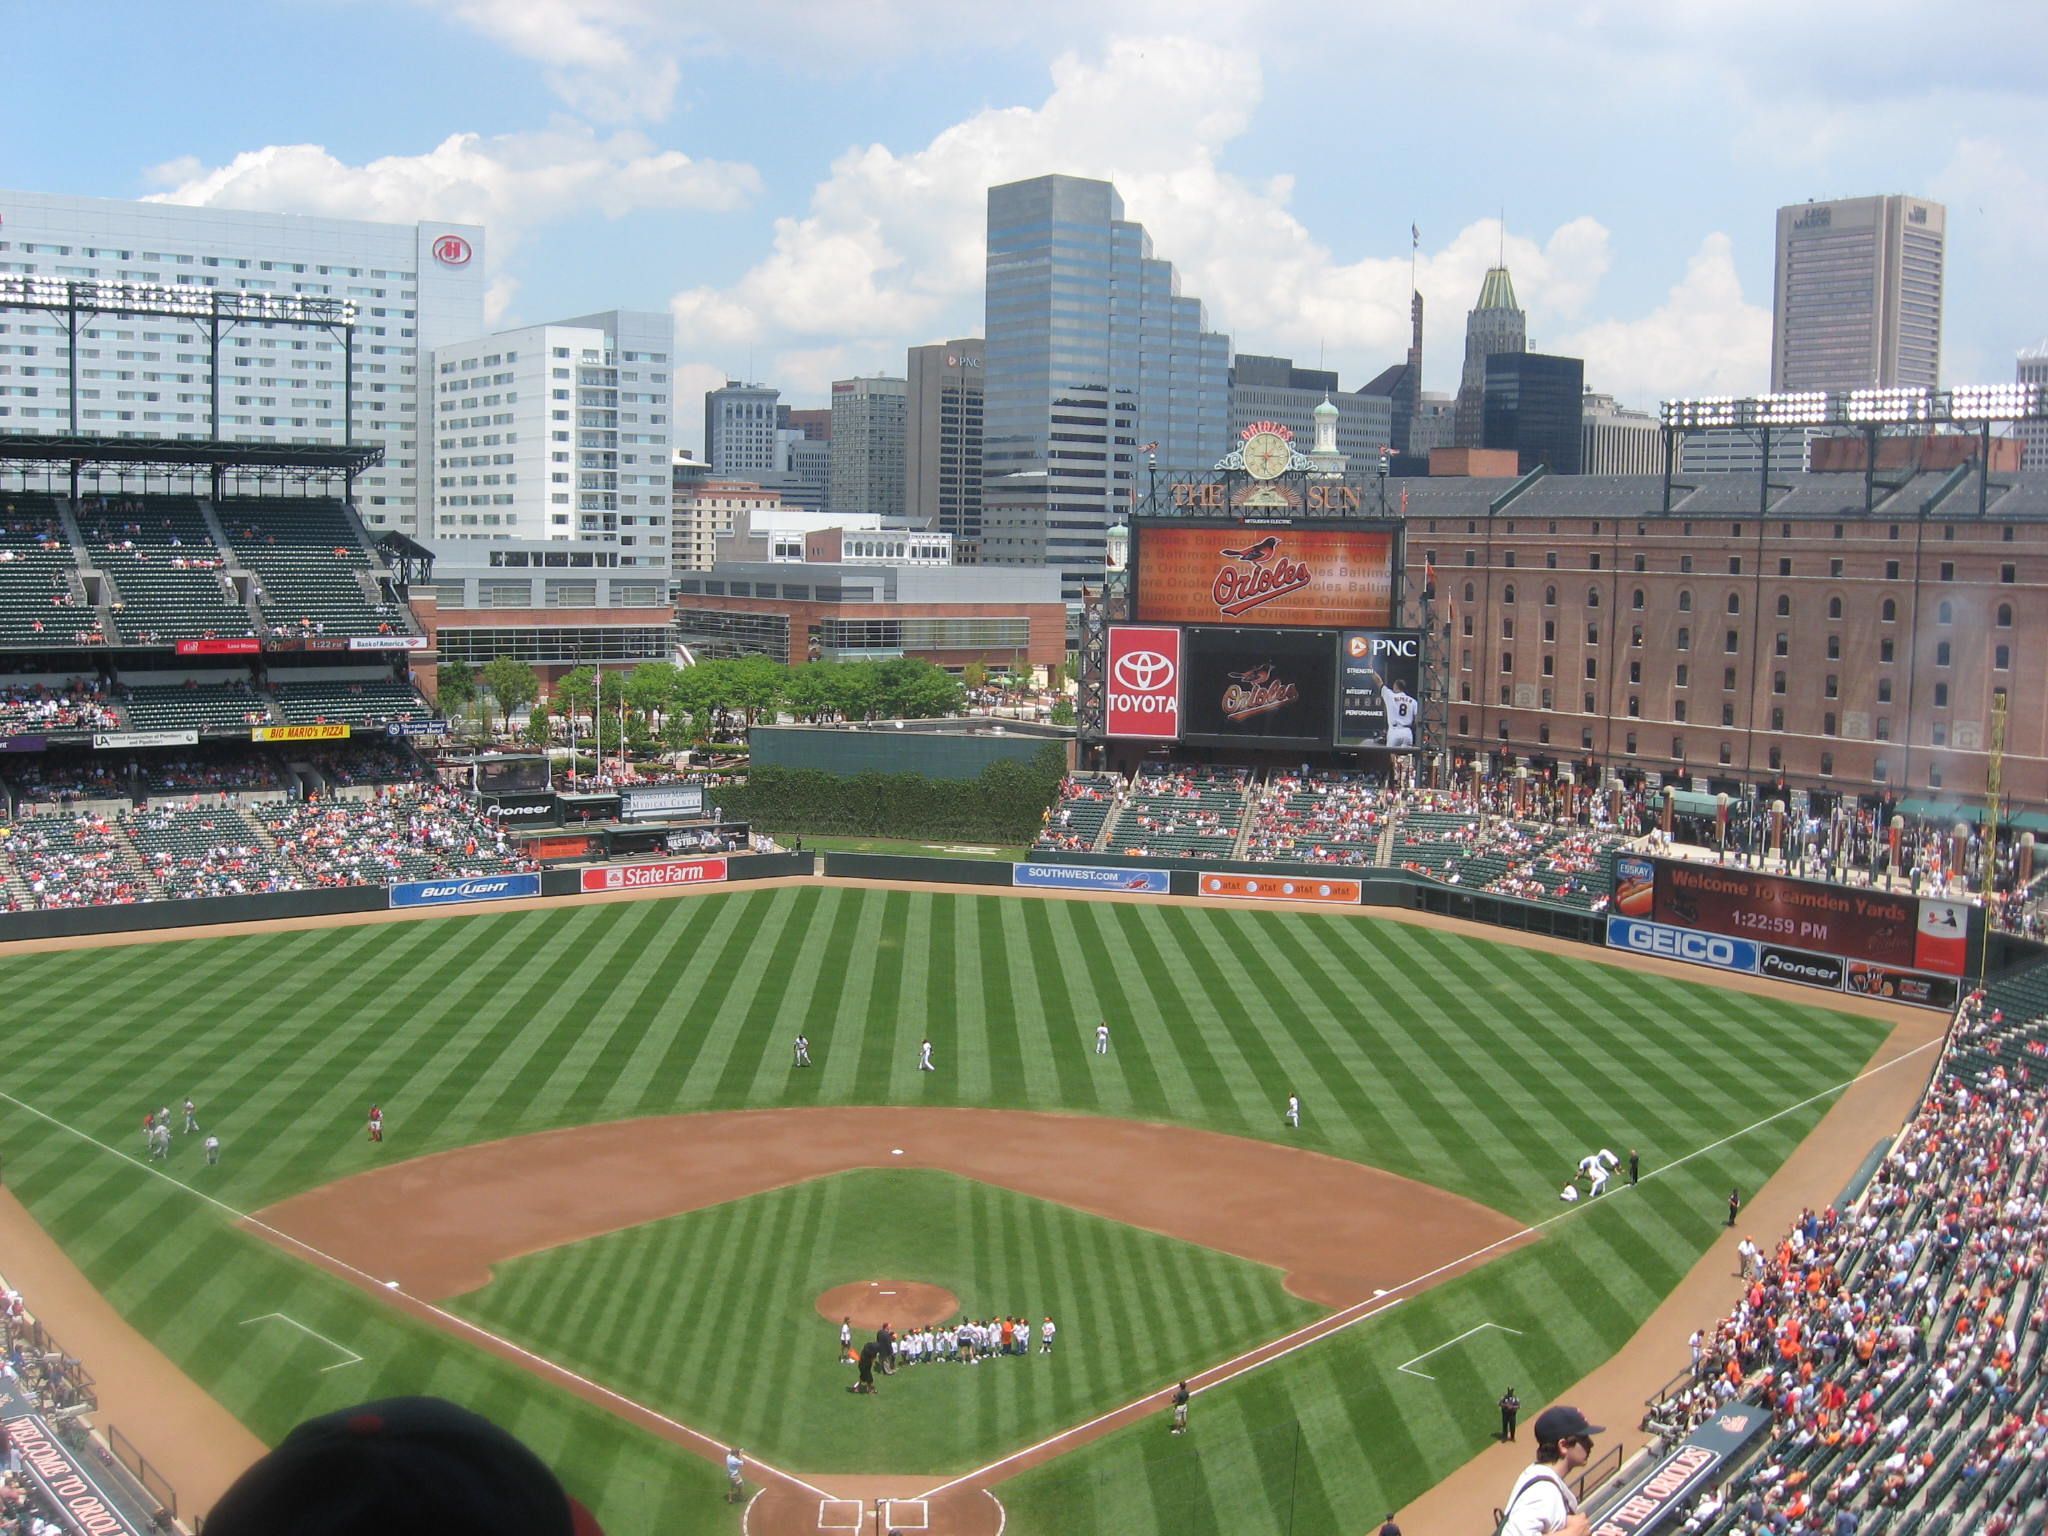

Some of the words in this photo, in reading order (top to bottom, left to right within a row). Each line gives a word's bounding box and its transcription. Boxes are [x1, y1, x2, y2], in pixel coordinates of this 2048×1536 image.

[959, 356, 980, 368] PNC
[1241, 420, 1294, 442] ORIOLES
[1171, 484, 1226, 506] THE
[1308, 486, 1362, 509] SUN
[1212, 557, 1311, 606] Orioles
[1371, 640, 1416, 657] PNC
[1109, 694, 1177, 713] TOYOTA
[1222, 680, 1299, 714] Orioles
[1345, 709, 1384, 717] PERFORMANCE
[1399, 704, 1407, 716] 8
[95, 736, 110, 746] UA
[270, 728, 284, 738] BIG
[287, 727, 318, 738] MARIO's
[322, 725, 344, 736] PIZZA
[486, 805, 551, 817] Pioneer
[632, 800, 669, 808] MEDICAL
[1029, 867, 1118, 881] SOUTHWEST.COM
[1620, 863, 1649, 877] ESSKAY
[421, 886, 457, 897] BUD
[463, 882, 508, 894] LIGHT
[1671, 869, 1749, 896] Welcome
[1755, 882, 1775, 901] To
[1780, 889, 1850, 912] Camden
[1856, 898, 1906, 921] Yards
[1732, 909, 1795, 934] 1:22:59
[1800, 921, 1828, 940] PM
[1628, 924, 1733, 965] GEICO
[1763, 955, 1838, 980] Pioneer
[5, 1417, 72, 1478] WELCOME
[51, 1475, 88, 1496] TO
[1610, 1495, 1661, 1525] THE
[1643, 1448, 1712, 1500] ORIOLES
[68, 1496, 130, 1536] ORIOL
